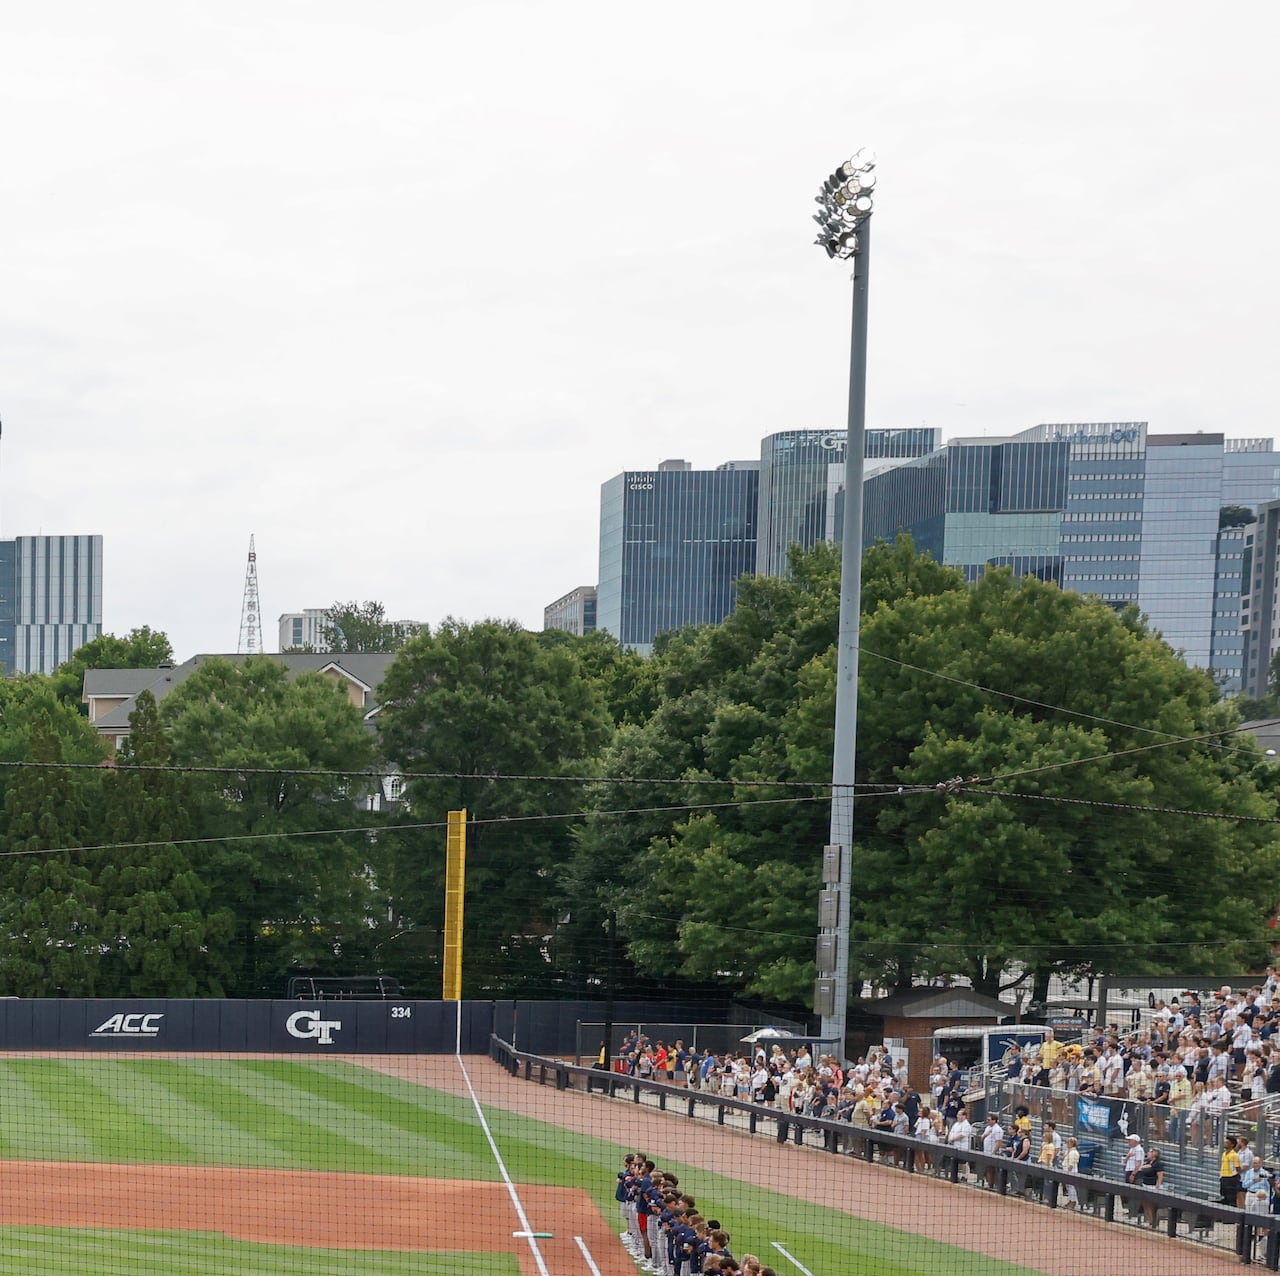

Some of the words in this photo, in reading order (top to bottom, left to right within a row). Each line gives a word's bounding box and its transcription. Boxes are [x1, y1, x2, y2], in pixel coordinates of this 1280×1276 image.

[93, 1013, 165, 1033] ACC
[391, 1007, 411, 1019] 334
[286, 1009, 341, 1045] GT
